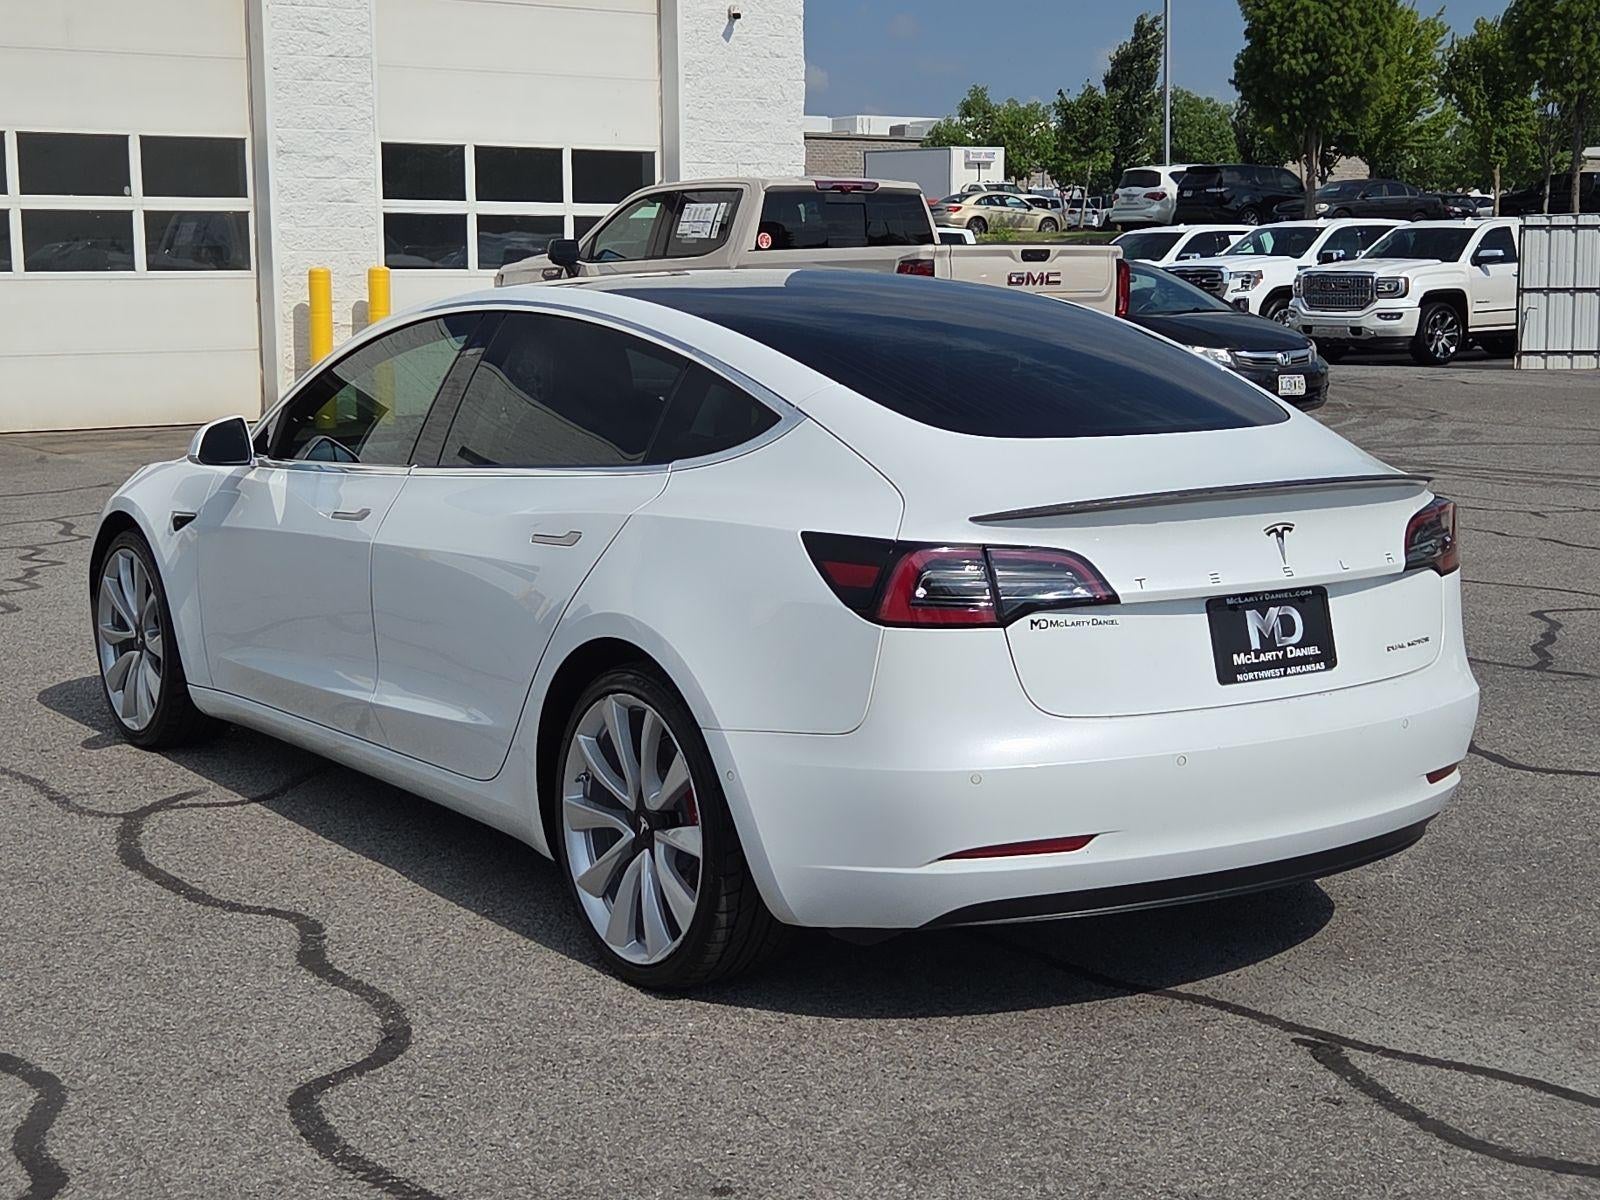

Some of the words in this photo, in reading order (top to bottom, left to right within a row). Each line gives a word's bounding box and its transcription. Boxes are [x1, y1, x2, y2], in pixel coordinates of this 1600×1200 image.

[1007, 272, 1061, 286] GMC
[1134, 552, 1395, 590] TESLA
[1091, 618, 1119, 626] DANIEL
[1286, 646, 1322, 658] DANIEL
[1236, 667, 1285, 682] NORTHWEST
[1286, 662, 1326, 675] ARKANSAS
